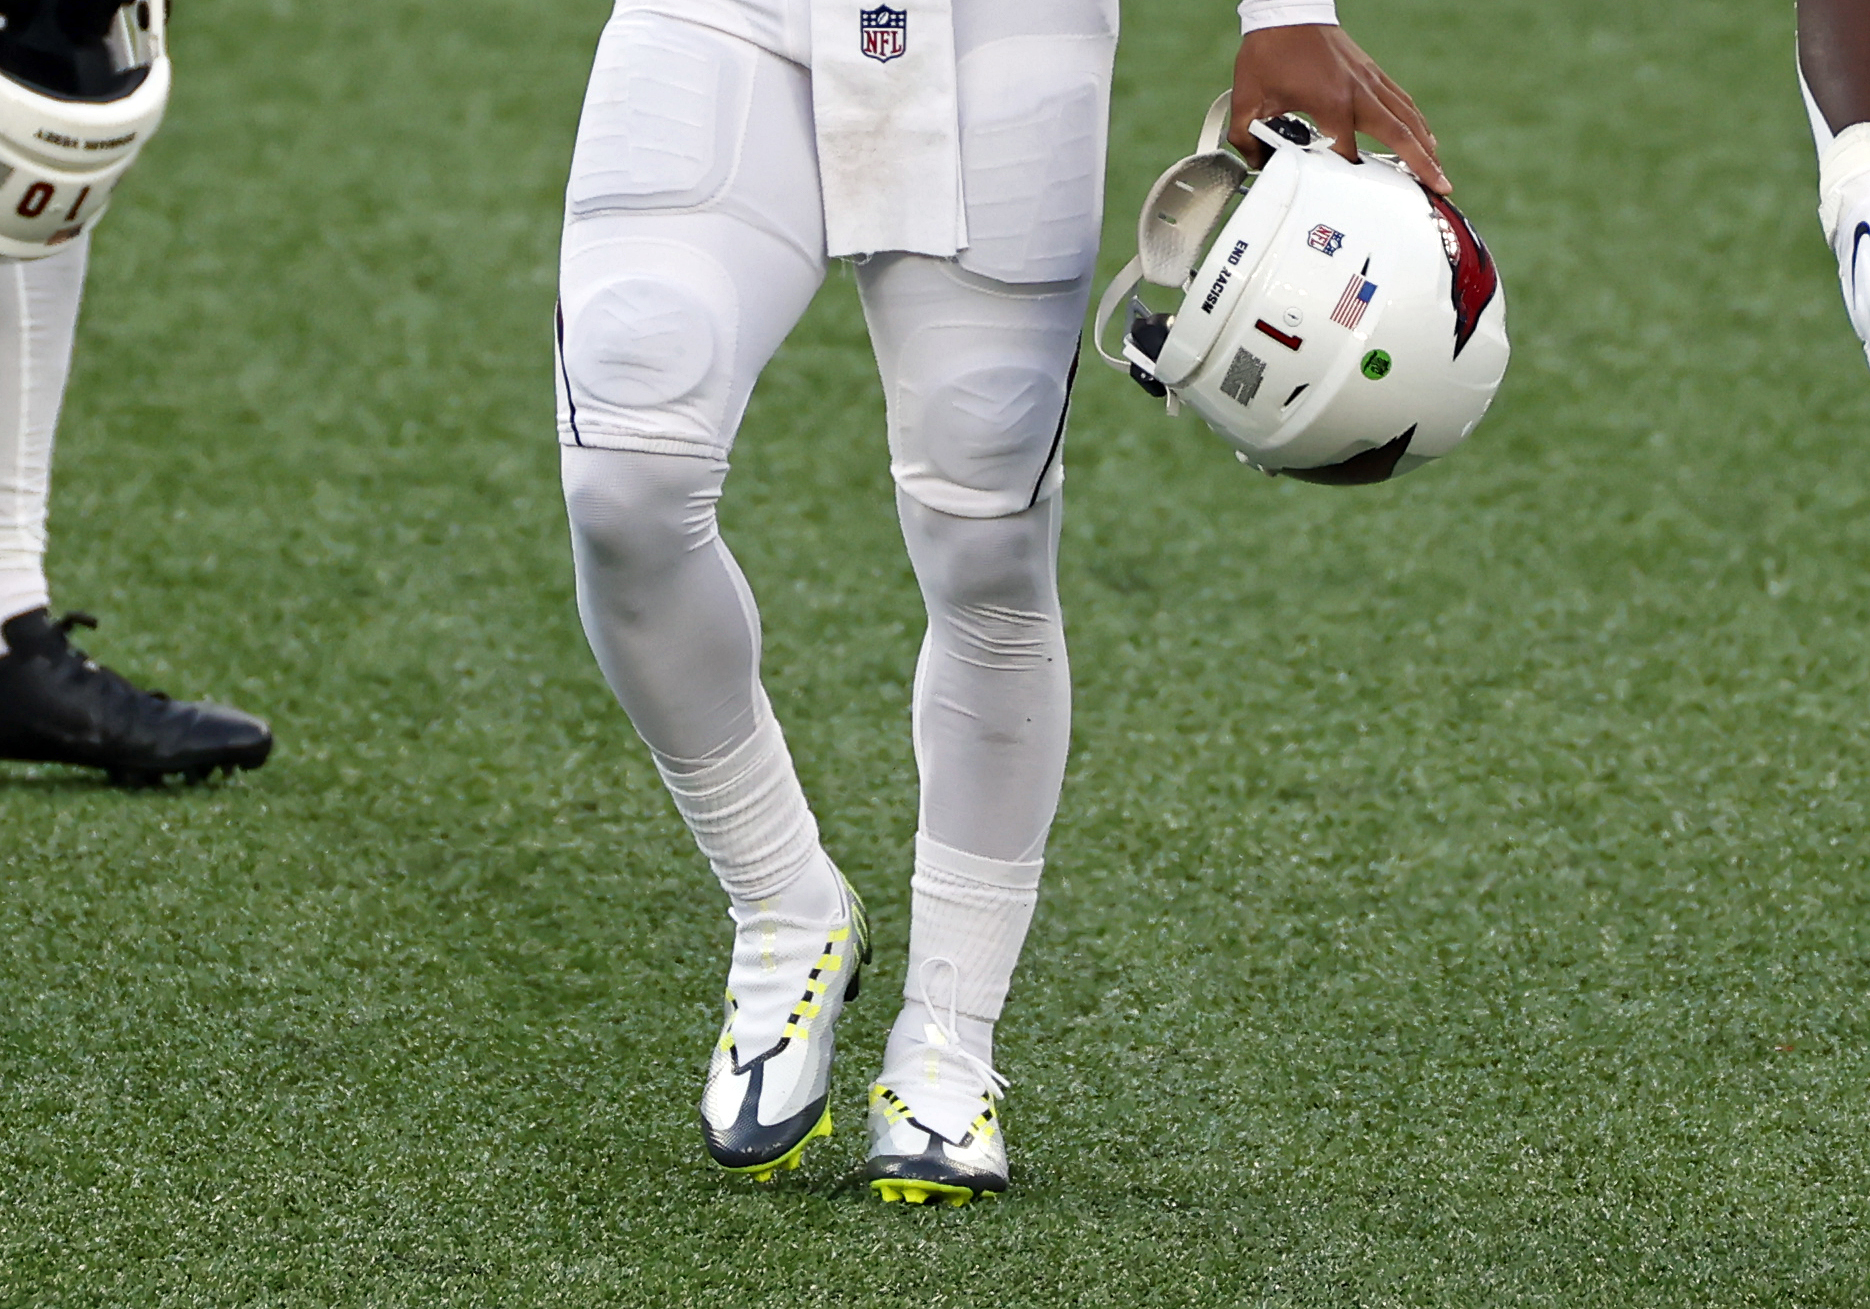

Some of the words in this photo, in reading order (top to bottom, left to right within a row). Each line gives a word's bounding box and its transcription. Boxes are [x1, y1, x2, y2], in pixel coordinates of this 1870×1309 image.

[863, 30, 902, 56] NFL
[16, 181, 91, 222] 10
[1310, 226, 1332, 247] NFL
[1227, 239, 1249, 266] END
[1201, 266, 1232, 315] RACISM
[1254, 318, 1303, 351] 1
